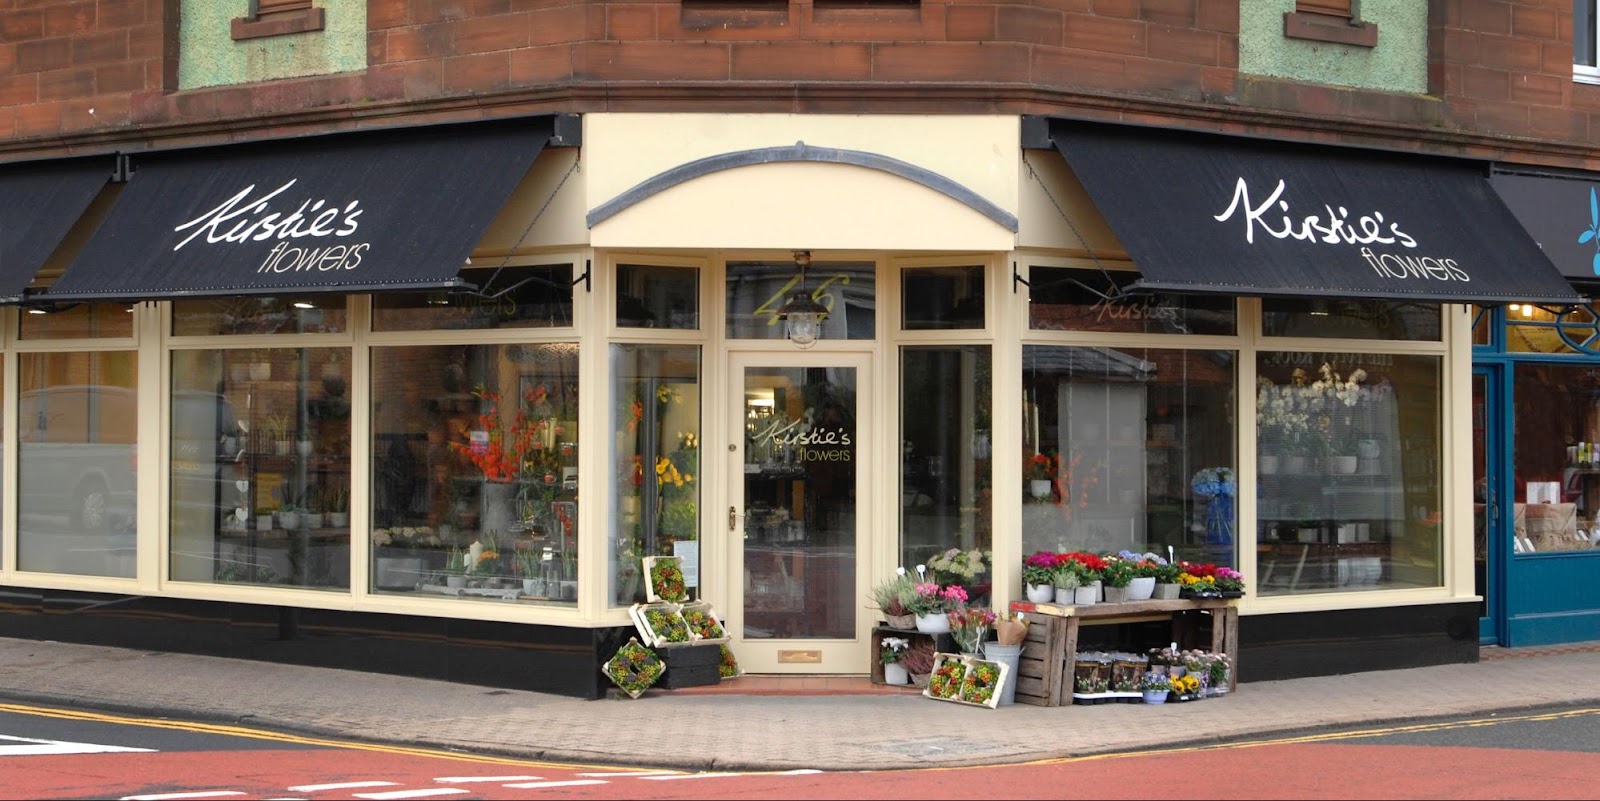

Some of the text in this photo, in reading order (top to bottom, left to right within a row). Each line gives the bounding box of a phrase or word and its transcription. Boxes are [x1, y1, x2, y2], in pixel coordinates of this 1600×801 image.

[174, 178, 364, 252] Kirstie's
[1213, 176, 1417, 248] Kirstie's
[257, 241, 370, 275] flowers
[1360, 246, 1470, 282] flowers
[752, 418, 851, 447] Kirstie's
[799, 447, 851, 462] flowers
